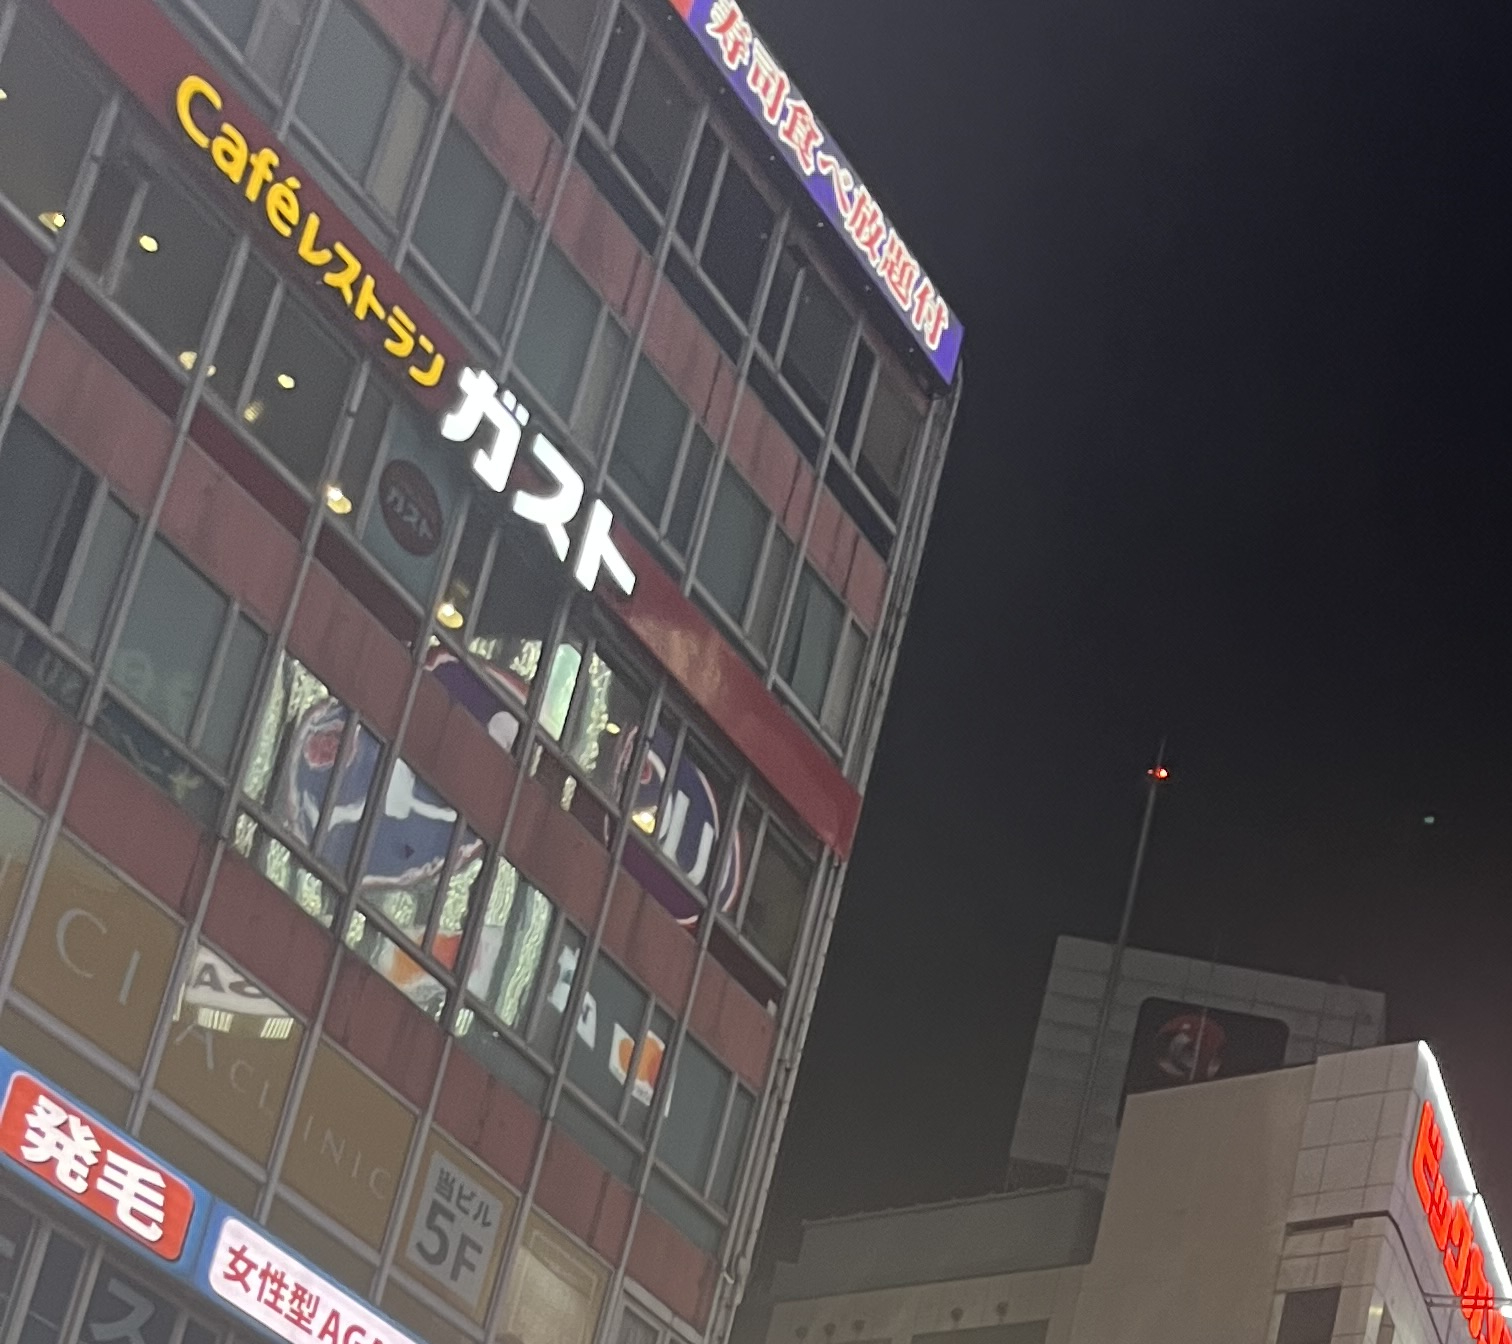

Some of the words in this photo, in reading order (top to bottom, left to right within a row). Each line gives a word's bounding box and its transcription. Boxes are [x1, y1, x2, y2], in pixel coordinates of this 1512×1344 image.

[440, 366, 637, 595] ガスト
[20, 1094, 168, 1244] 発毛
[432, 1153, 498, 1231] 当ビル
[415, 1206, 484, 1284] 5F
